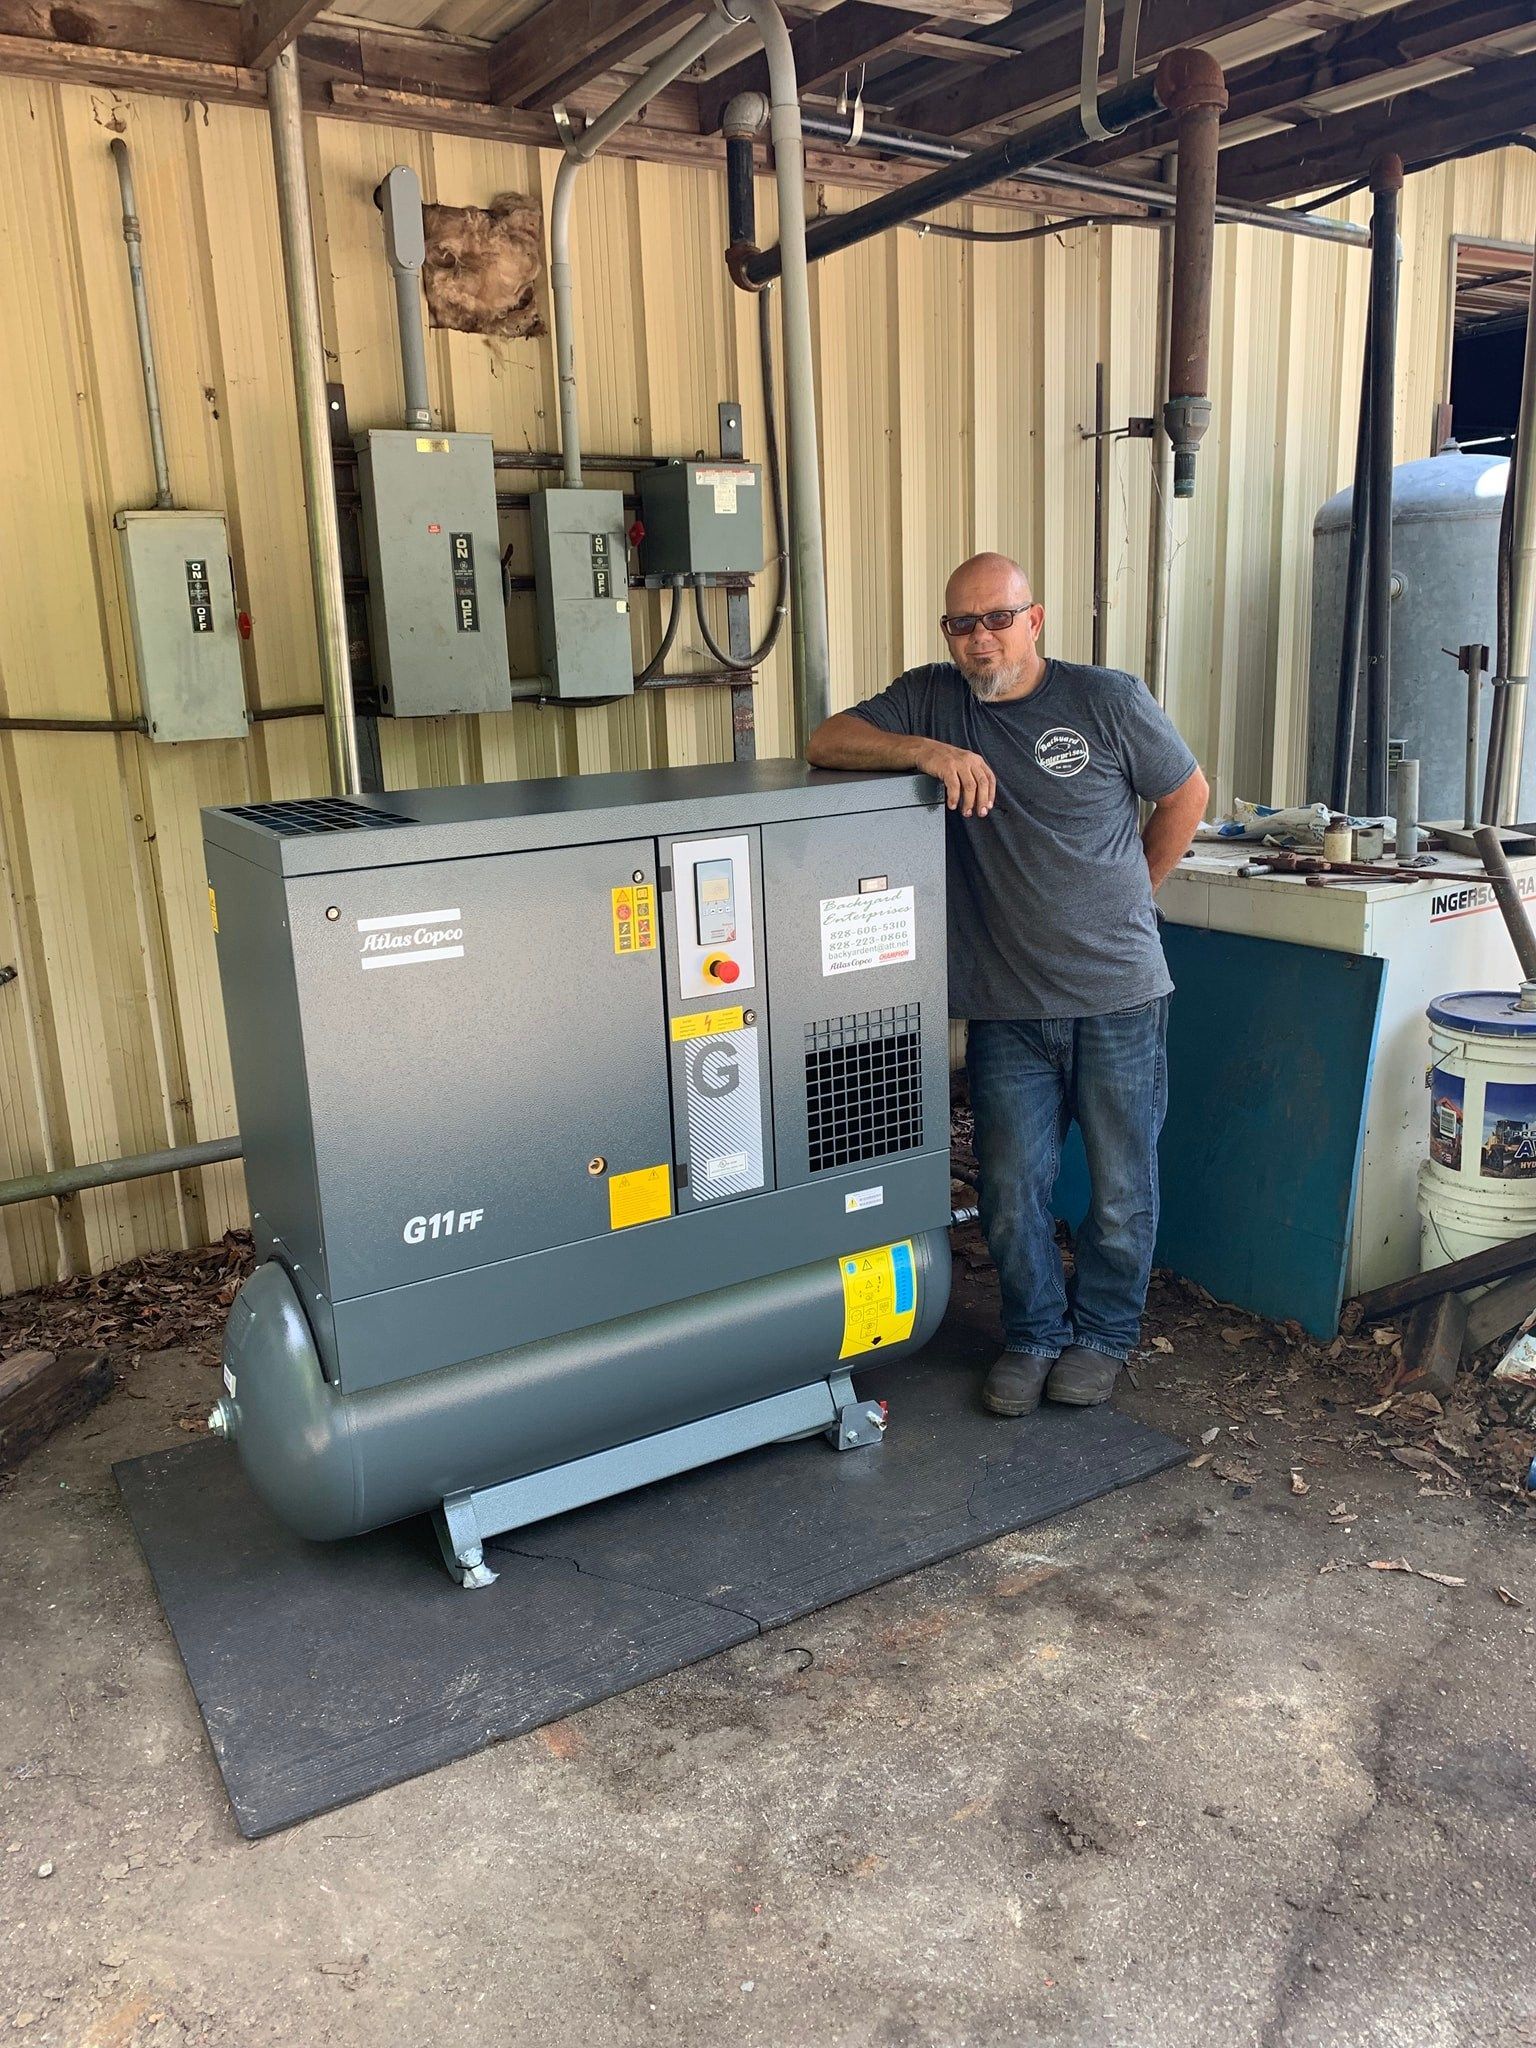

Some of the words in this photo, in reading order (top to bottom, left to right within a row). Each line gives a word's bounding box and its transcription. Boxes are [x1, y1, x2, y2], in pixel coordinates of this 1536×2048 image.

[456, 538, 468, 559] ON
[595, 537, 603, 553] ON
[191, 563, 202, 579] ON
[597, 572, 605, 594] OFF
[196, 607, 207, 631] OFF
[461, 599, 472, 628] OFF
[1041, 736, 1080, 752] Backyard
[823, 889, 902, 912] Backyard
[1432, 885, 1498, 915] INGERSO
[823, 905, 912, 926] Enterprises
[360, 931, 412, 952] Atlas
[413, 928, 463, 946] Copco
[830, 920, 907, 940] 828-606-5310
[828, 940, 909, 960] backyardent@att.net
[829, 931, 908, 951] 828-223-0866
[692, 1041, 740, 1098] G
